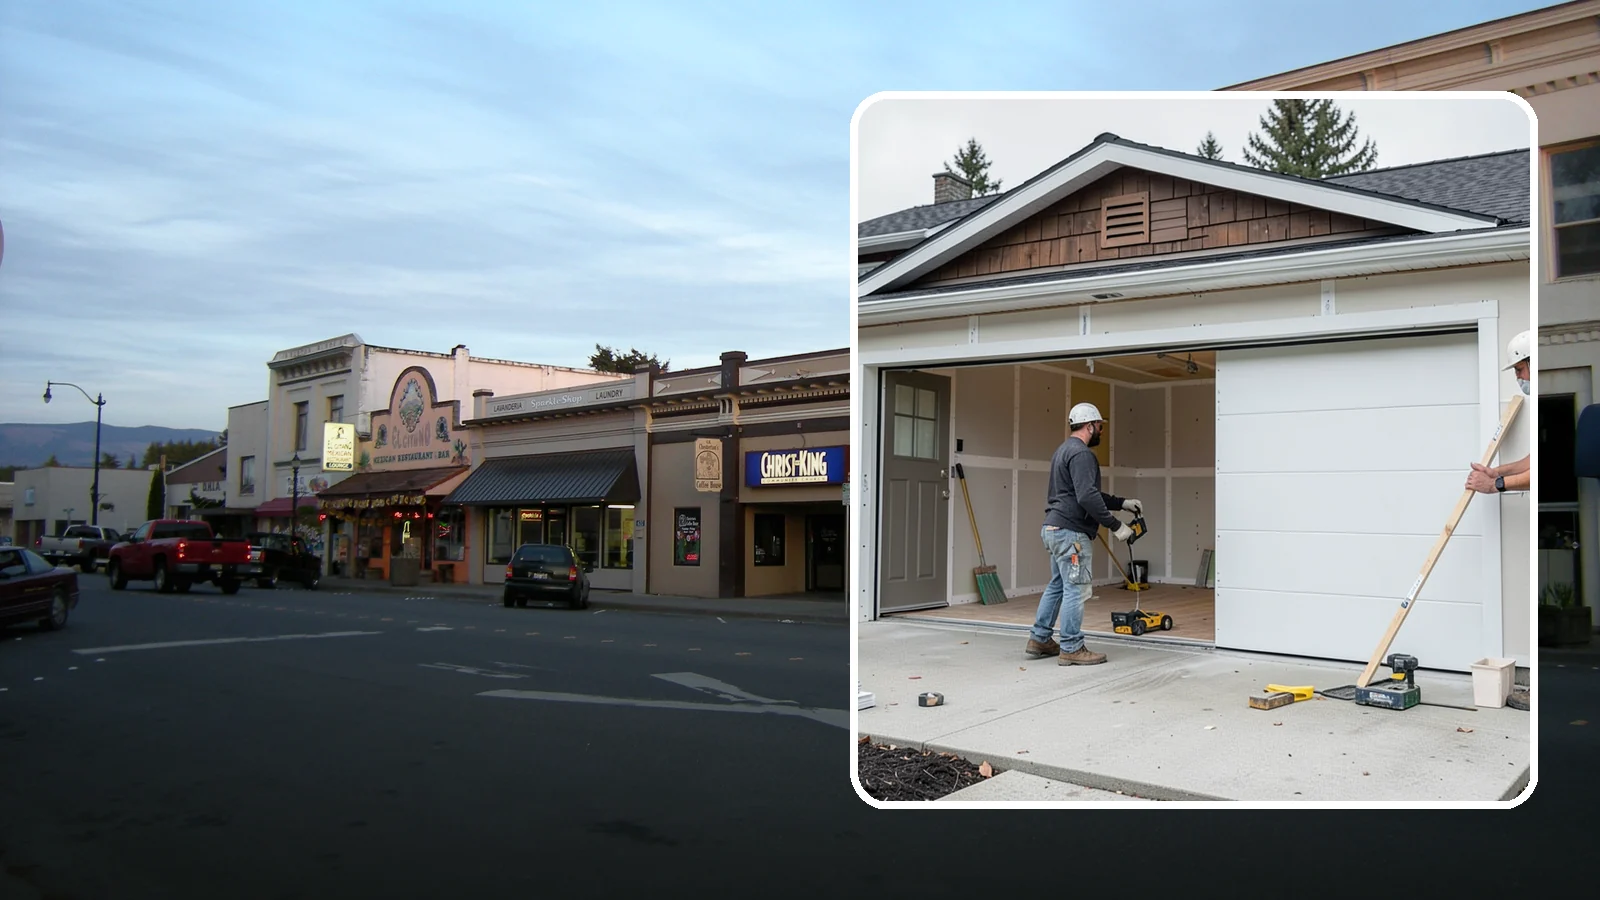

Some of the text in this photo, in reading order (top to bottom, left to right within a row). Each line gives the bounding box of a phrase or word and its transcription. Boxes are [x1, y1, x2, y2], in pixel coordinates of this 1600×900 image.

[530, 394, 582, 409] Sparkle Shop
[595, 389, 623, 400] LAUNDRY
[494, 402, 522, 412] LAVANDERIA
[391, 425, 402, 449] EL
[374, 454, 396, 464] MEXICAN
[397, 451, 434, 462] RESTAURANT
[438, 449, 450, 459] BAR
[760, 450, 827, 478] CHRIST KING
[696, 480, 721, 488] Coffee House
